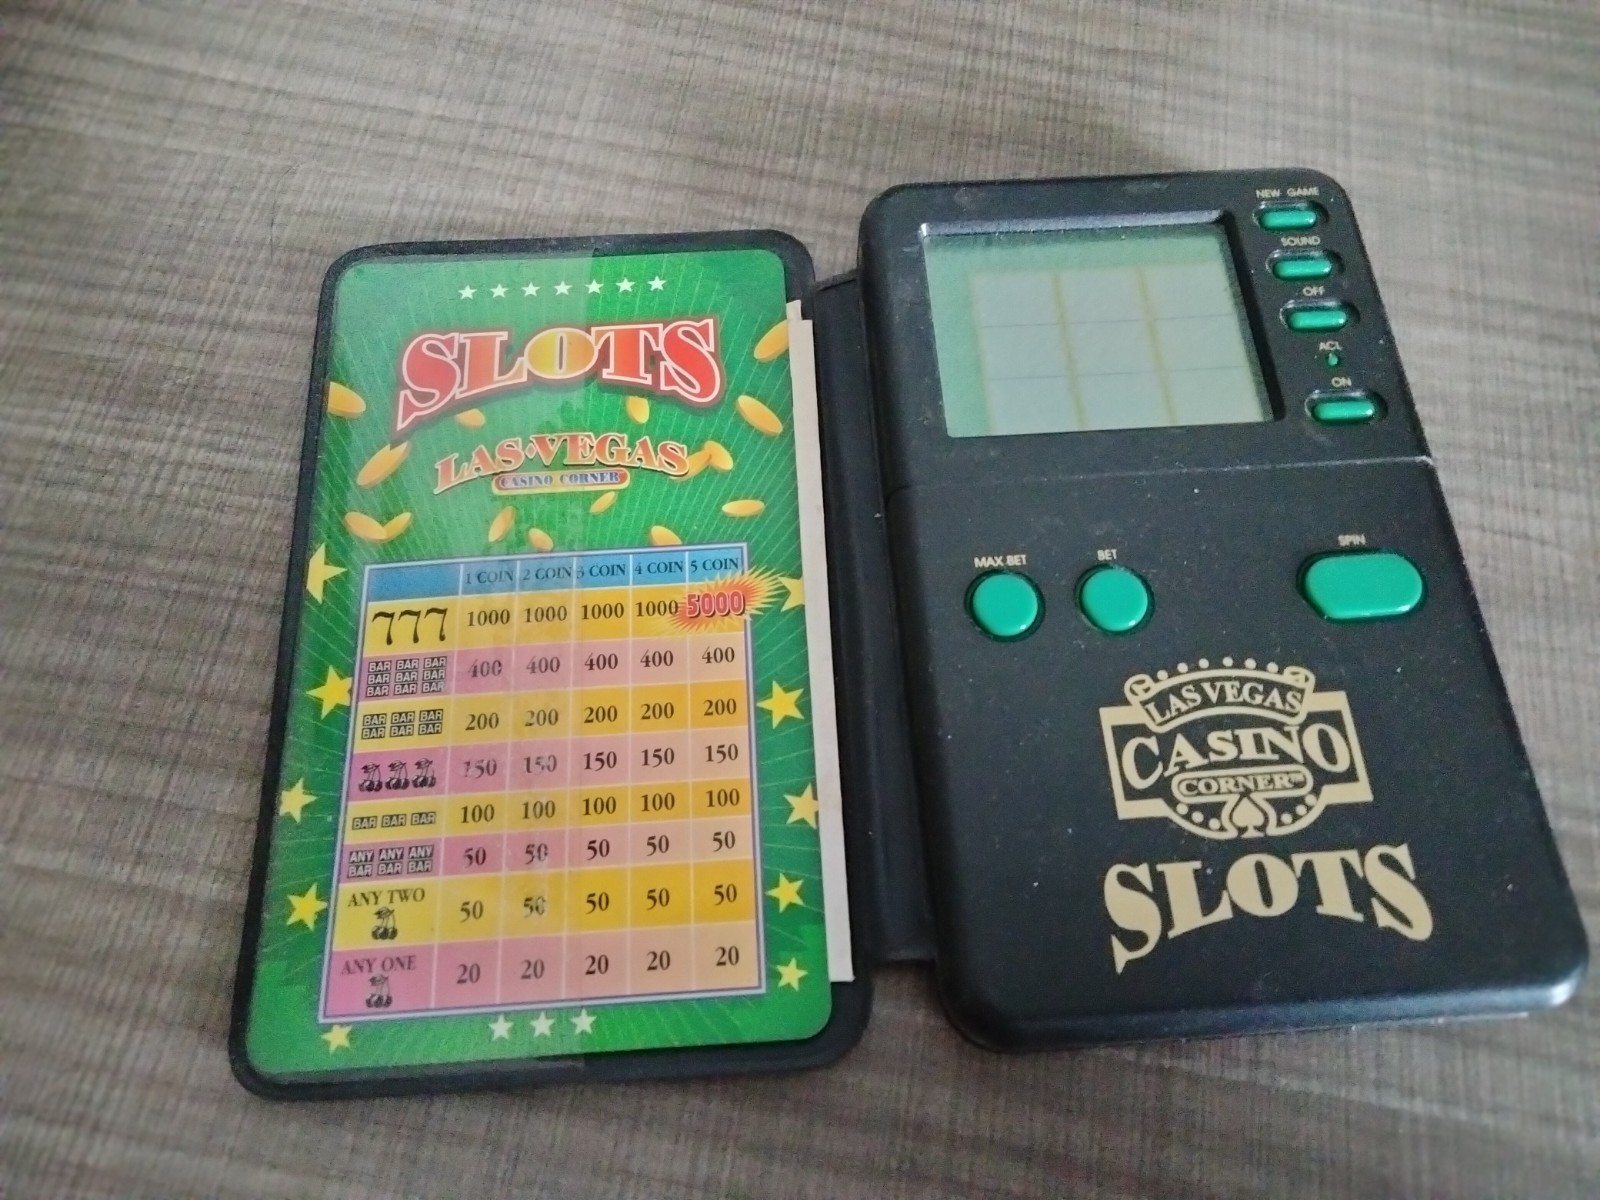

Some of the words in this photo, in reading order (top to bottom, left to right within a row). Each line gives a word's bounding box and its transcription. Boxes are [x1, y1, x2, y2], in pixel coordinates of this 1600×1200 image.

[1256, 189, 1281, 198] NEW
[1287, 187, 1319, 197] GAME
[1281, 236, 1321, 246] SOUND
[1302, 286, 1325, 296] OFF
[395, 318, 722, 431] SLOTS
[1331, 377, 1352, 387] ON
[433, 437, 525, 495] LAS
[530, 432, 690, 476] VEGAS
[500, 473, 553, 488] CASINO
[559, 471, 620, 485] CORNER
[1338, 534, 1366, 547] SPIN
[974, 556, 1003, 568] MAX
[1006, 554, 1027, 566] BET
[1097, 549, 1118, 561] BET
[466, 573, 472, 584] 1
[477, 570, 514, 584] COIN
[522, 569, 530, 581] 2
[535, 566, 573, 580] COIN
[590, 563, 626, 578] COIN
[634, 564, 642, 575] 4
[647, 561, 684, 574] COIN
[690, 560, 698, 574] 5
[702, 558, 740, 571] COIN
[468, 608, 511, 627] 1000
[524, 605, 568, 624] 1000
[581, 602, 624, 620] 1000
[635, 600, 679, 617] 1000
[686, 589, 746, 619] 5000
[369, 661, 391, 672] BAR
[396, 659, 419, 670] BAR
[424, 657, 447, 668] BAR
[468, 659, 502, 678] 400
[526, 656, 560, 674] 400
[584, 652, 619, 671] 400
[640, 649, 674, 668] 400
[701, 646, 736, 665] 400
[368, 674, 390, 685] BAR
[396, 671, 418, 682] BAR
[424, 669, 446, 680] BAR
[366, 686, 389, 697] BAR
[394, 684, 417, 695] BAR
[422, 681, 446, 693] BAR
[1144, 684, 1202, 724] LAS
[1200, 680, 1302, 714] VEGAS
[364, 714, 386, 726] BAR
[392, 712, 415, 724] BAR
[420, 709, 443, 722] BAR
[465, 712, 500, 731] 200
[524, 708, 559, 727] 200
[583, 705, 618, 724] 200
[640, 702, 675, 721] 200
[703, 697, 738, 716] 200
[362, 727, 385, 739] BAR
[390, 724, 414, 737] BAR
[418, 722, 442, 735] BAR
[584, 751, 618, 772] 150
[640, 747, 675, 768] 150
[704, 743, 739, 764] 150
[1122, 722, 1351, 790] CASINO
[353, 816, 377, 830] BAR
[382, 814, 406, 828] BAR
[411, 812, 436, 825] BAR
[460, 804, 495, 824] 100
[522, 800, 556, 820] 100
[582, 796, 617, 816] 100
[640, 792, 676, 812] 100
[705, 788, 740, 808] 100
[350, 850, 374, 862] ANY
[380, 848, 404, 861] ANY
[409, 846, 434, 858] ANY
[464, 846, 486, 868] 50
[525, 843, 548, 865] 50
[586, 838, 610, 861] 50
[646, 834, 671, 856] 50
[712, 830, 736, 852] 50
[348, 865, 372, 878] BAR
[378, 862, 402, 876] BAR
[408, 860, 432, 873] BAR
[348, 890, 382, 907] ANY
[388, 888, 426, 904] TWO
[460, 900, 484, 923] 50
[524, 896, 546, 918] 50
[586, 892, 610, 916] 50
[646, 888, 671, 910] 50
[713, 884, 738, 906] 50
[1104, 843, 1434, 975] SLOTS
[342, 958, 377, 976] ANY
[382, 954, 417, 972] ONE
[456, 963, 481, 984] 20
[520, 959, 545, 981] 20
[584, 954, 610, 976] 20
[646, 950, 672, 972] 20
[715, 945, 740, 968] 20
